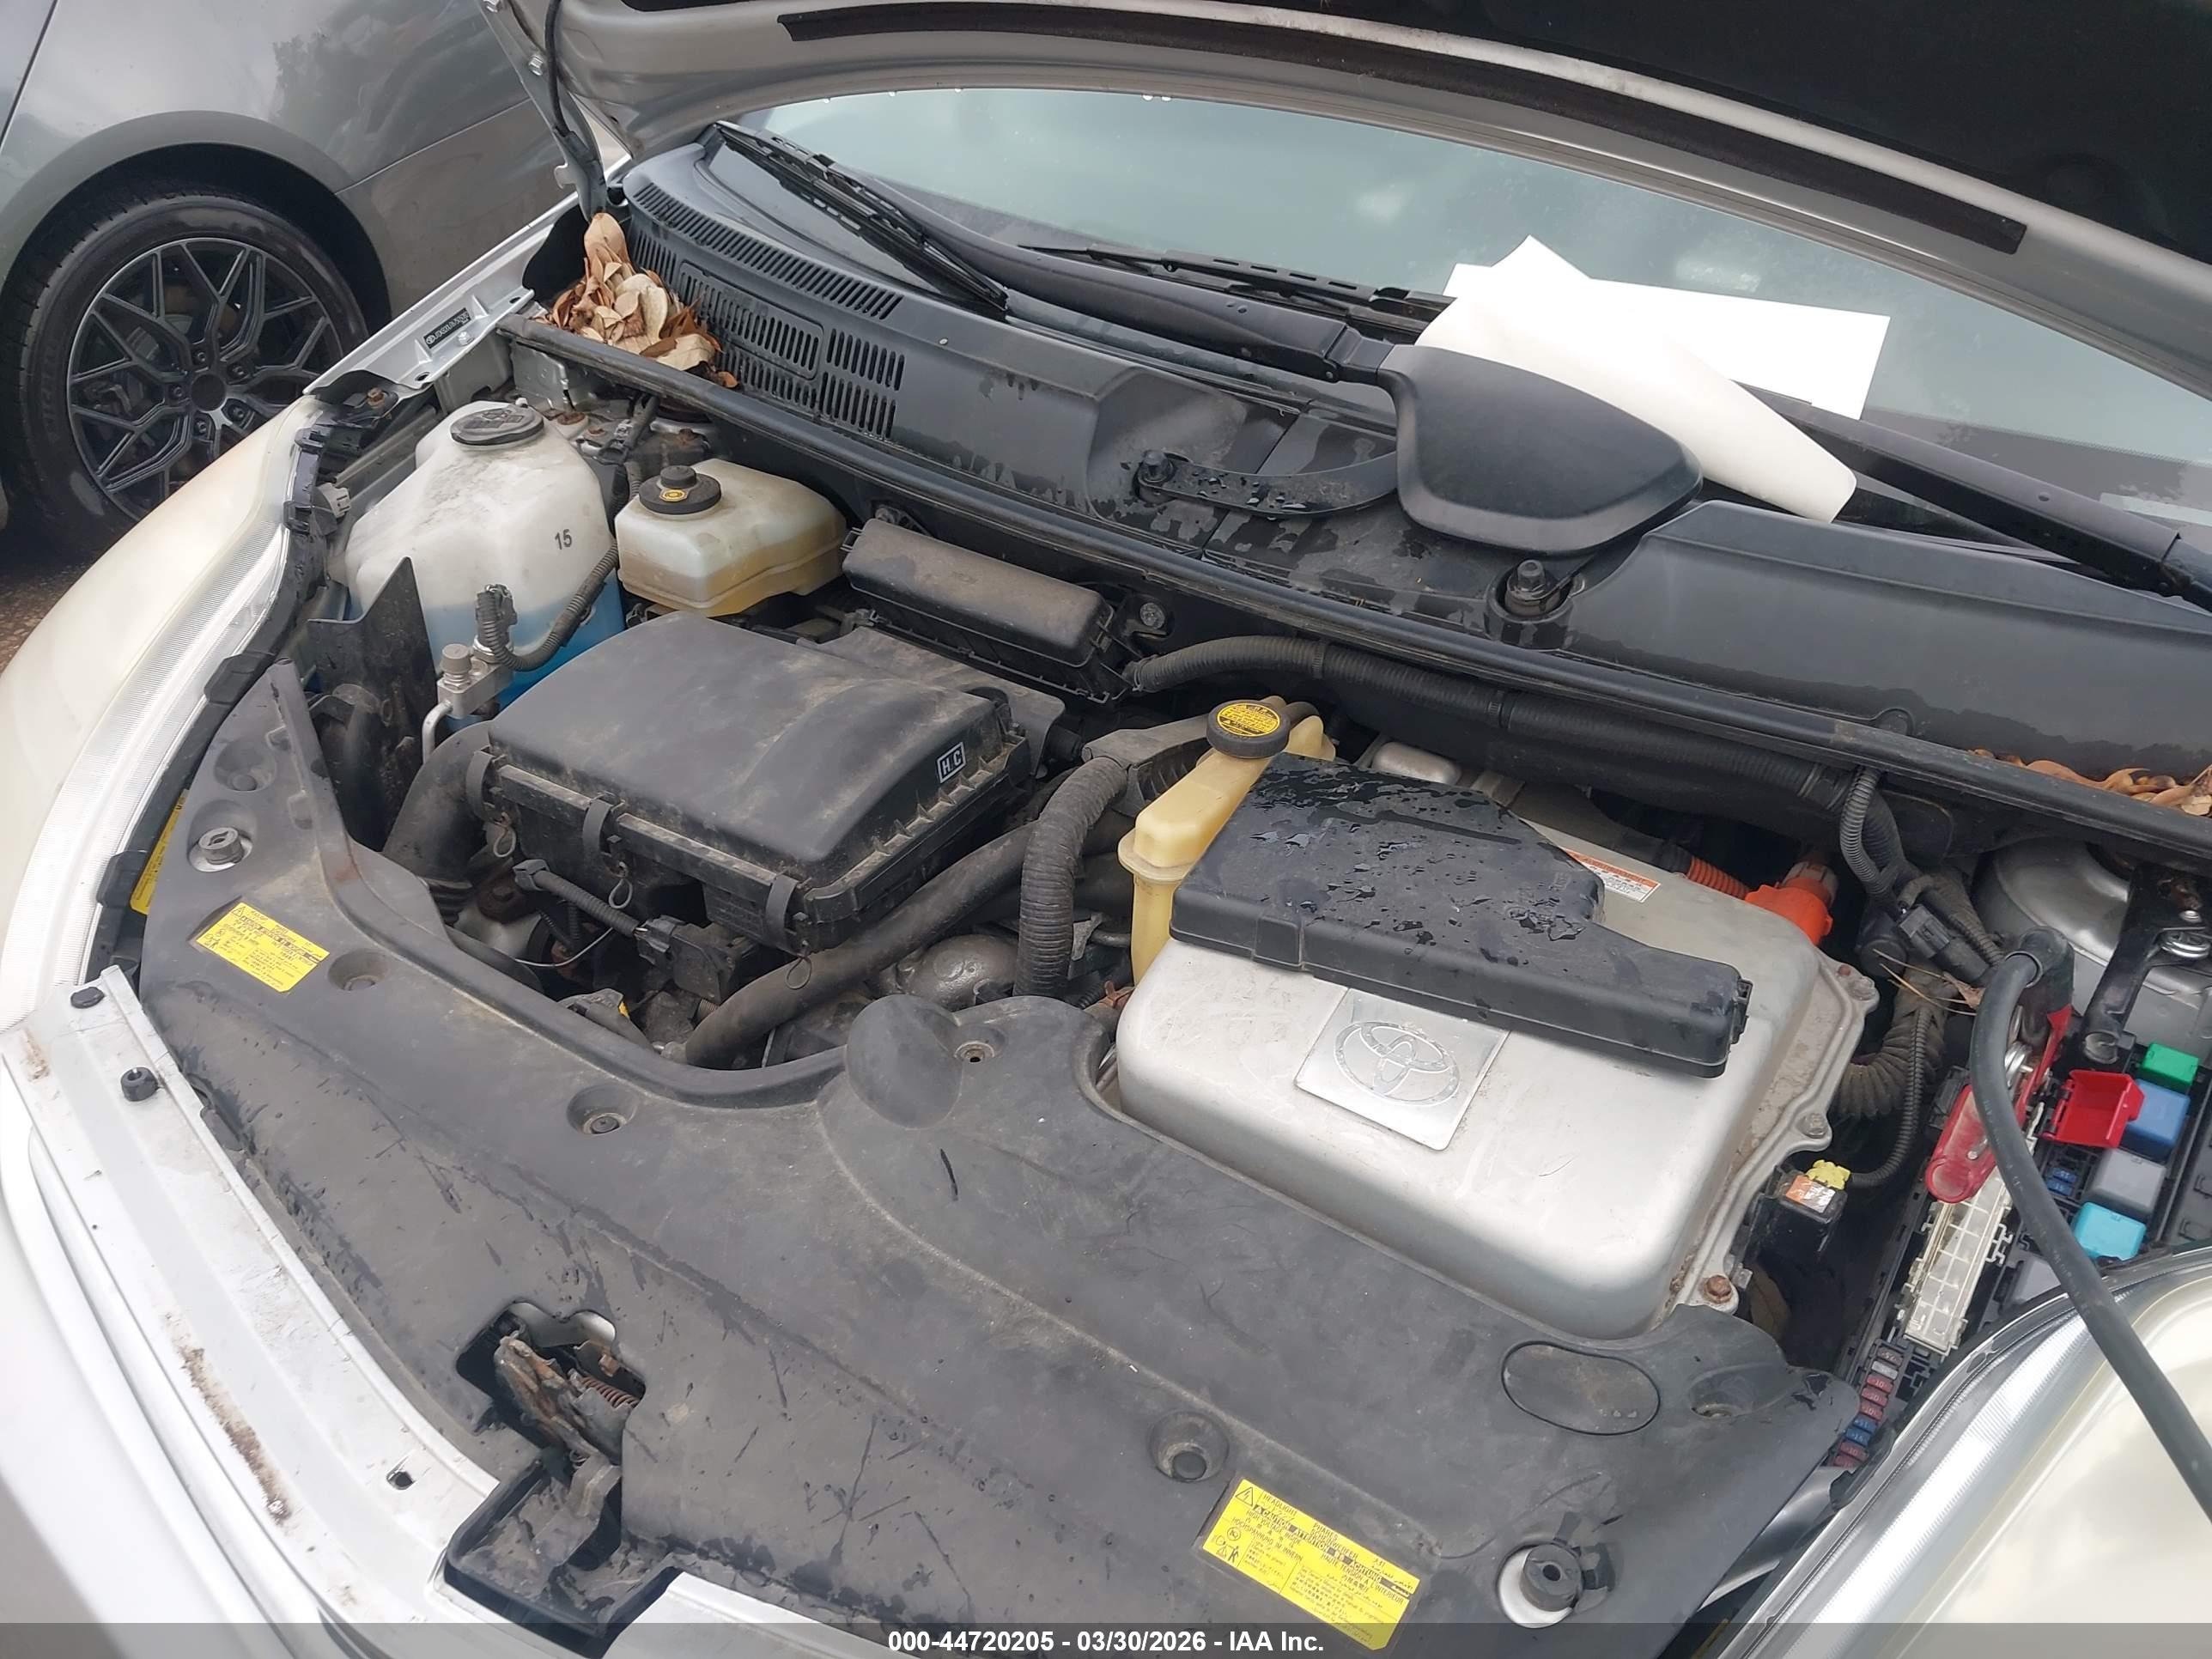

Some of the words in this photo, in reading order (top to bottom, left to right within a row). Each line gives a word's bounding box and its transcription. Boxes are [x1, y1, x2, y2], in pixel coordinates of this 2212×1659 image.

[554, 528, 573, 550] 15
[1262, 1493, 1297, 1517] HEADLIGHT
[1245, 1509, 1261, 1522] HIGH
[1259, 1517, 1285, 1536] VOLTAGE
[1284, 1531, 1302, 1546] INSIDE
[1261, 1509, 1291, 1530] CAUTION
[1348, 1559, 1382, 1583] ACHTUNG
[1338, 1563, 1364, 1583] TENSION
